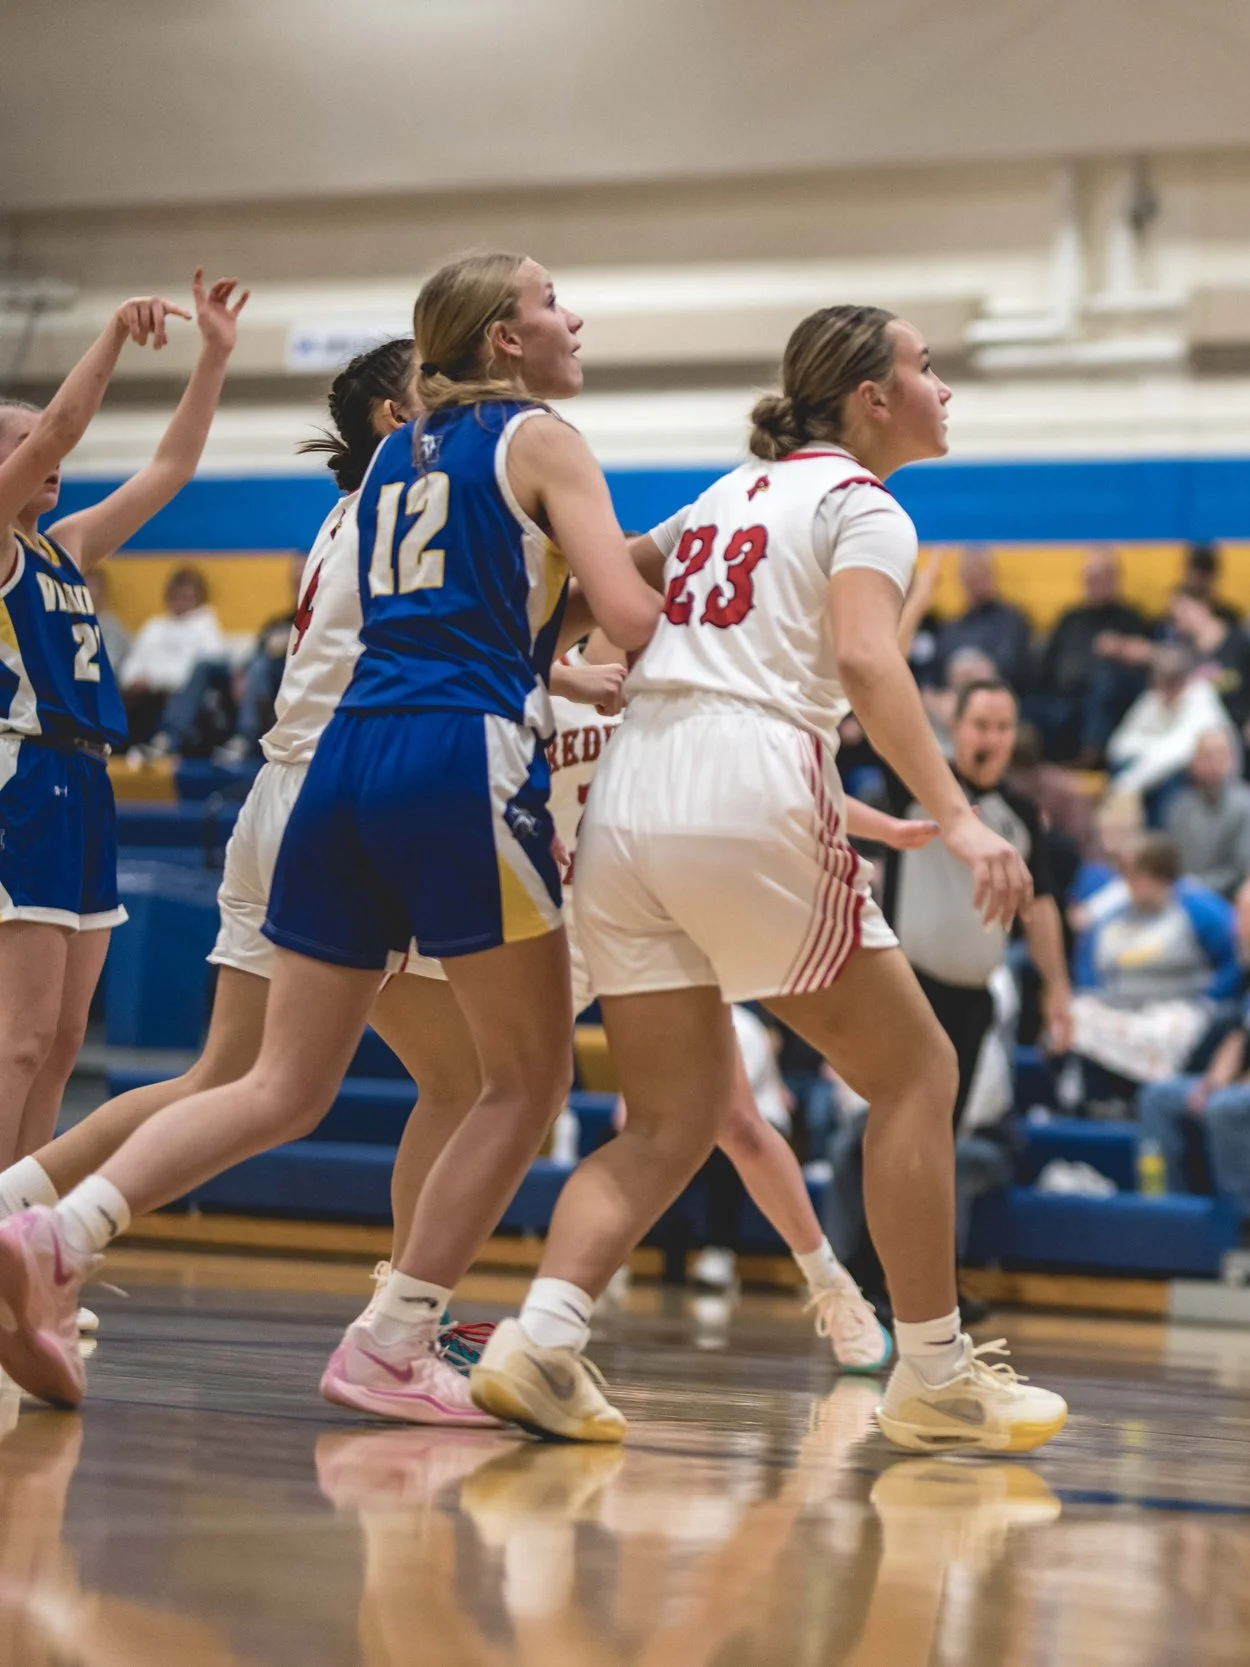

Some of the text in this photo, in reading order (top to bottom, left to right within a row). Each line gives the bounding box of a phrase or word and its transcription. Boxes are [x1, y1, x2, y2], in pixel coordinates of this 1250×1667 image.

[368, 471, 450, 599] 12
[661, 523, 769, 629] 23
[72, 622, 101, 683] 2
